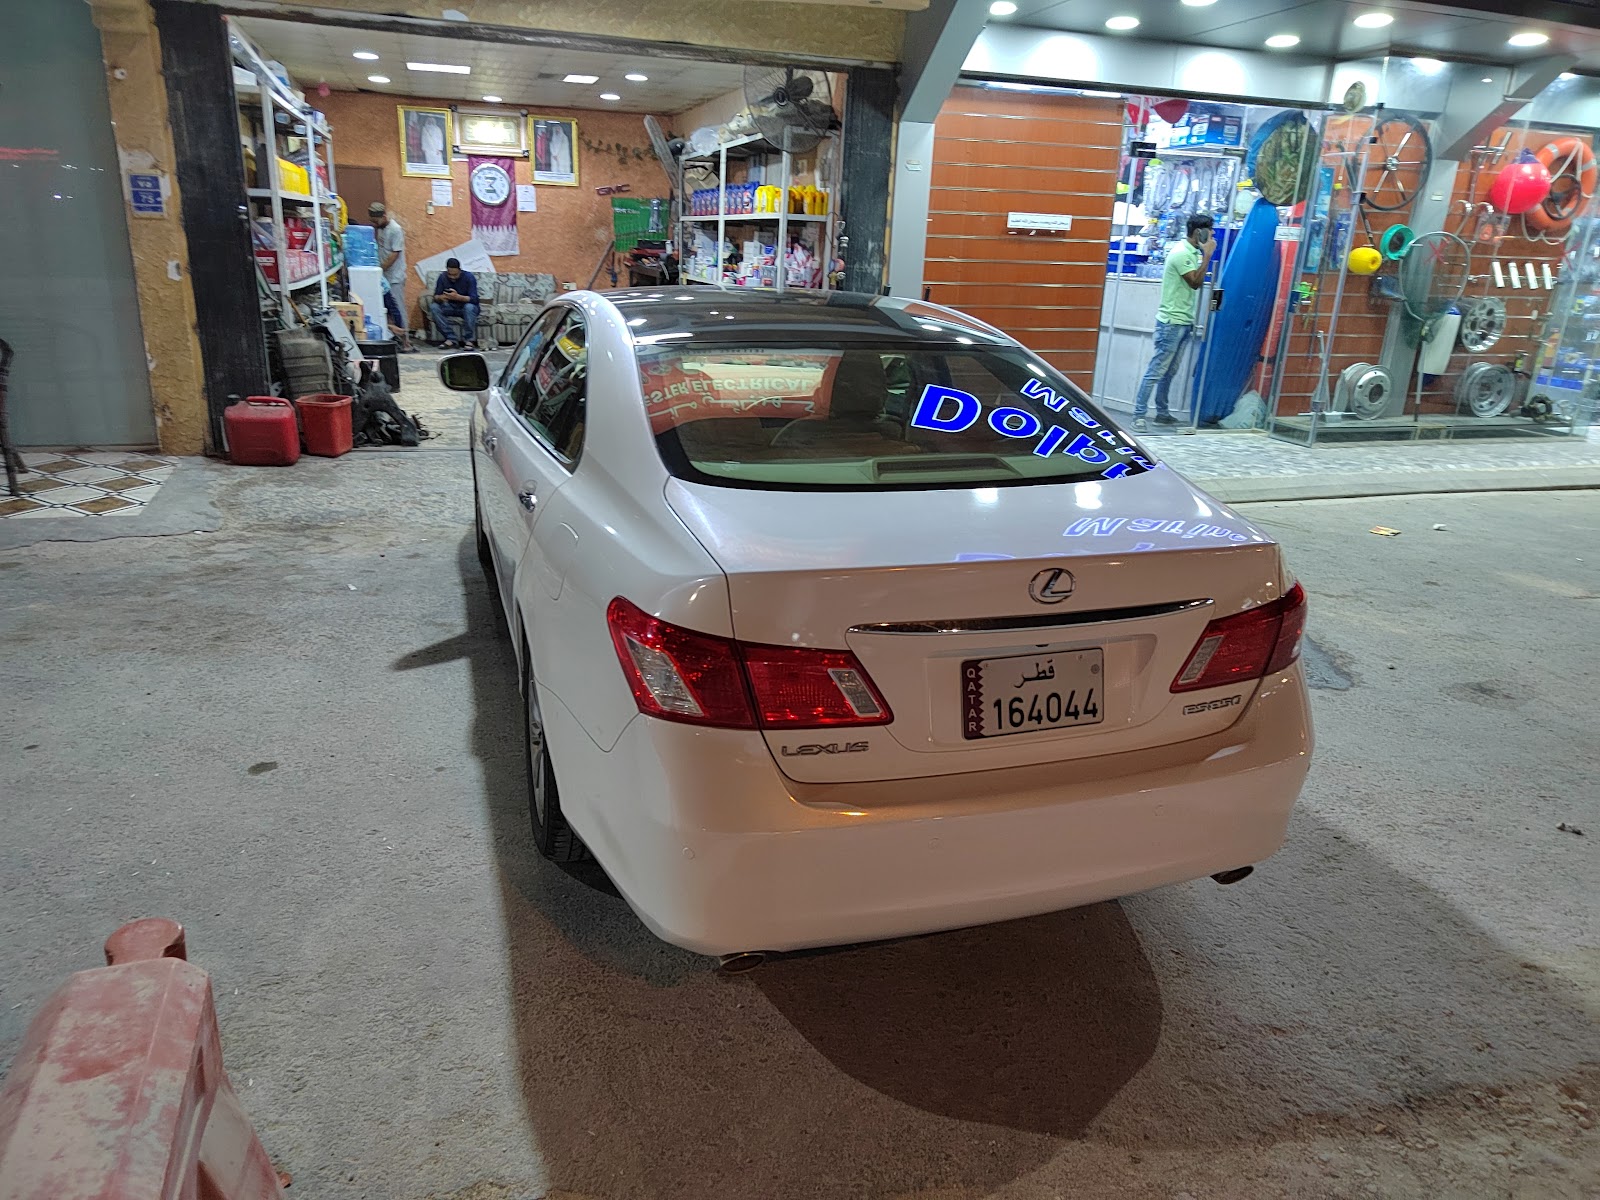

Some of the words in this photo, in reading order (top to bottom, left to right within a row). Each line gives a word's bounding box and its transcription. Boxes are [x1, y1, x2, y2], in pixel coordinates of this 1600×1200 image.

[595, 184, 631, 195] GMC
[1014, 659, 1055, 688] قطر
[966, 668, 977, 732] QATAR
[993, 688, 1098, 729] 164044
[781, 741, 869, 757] LEXUS
